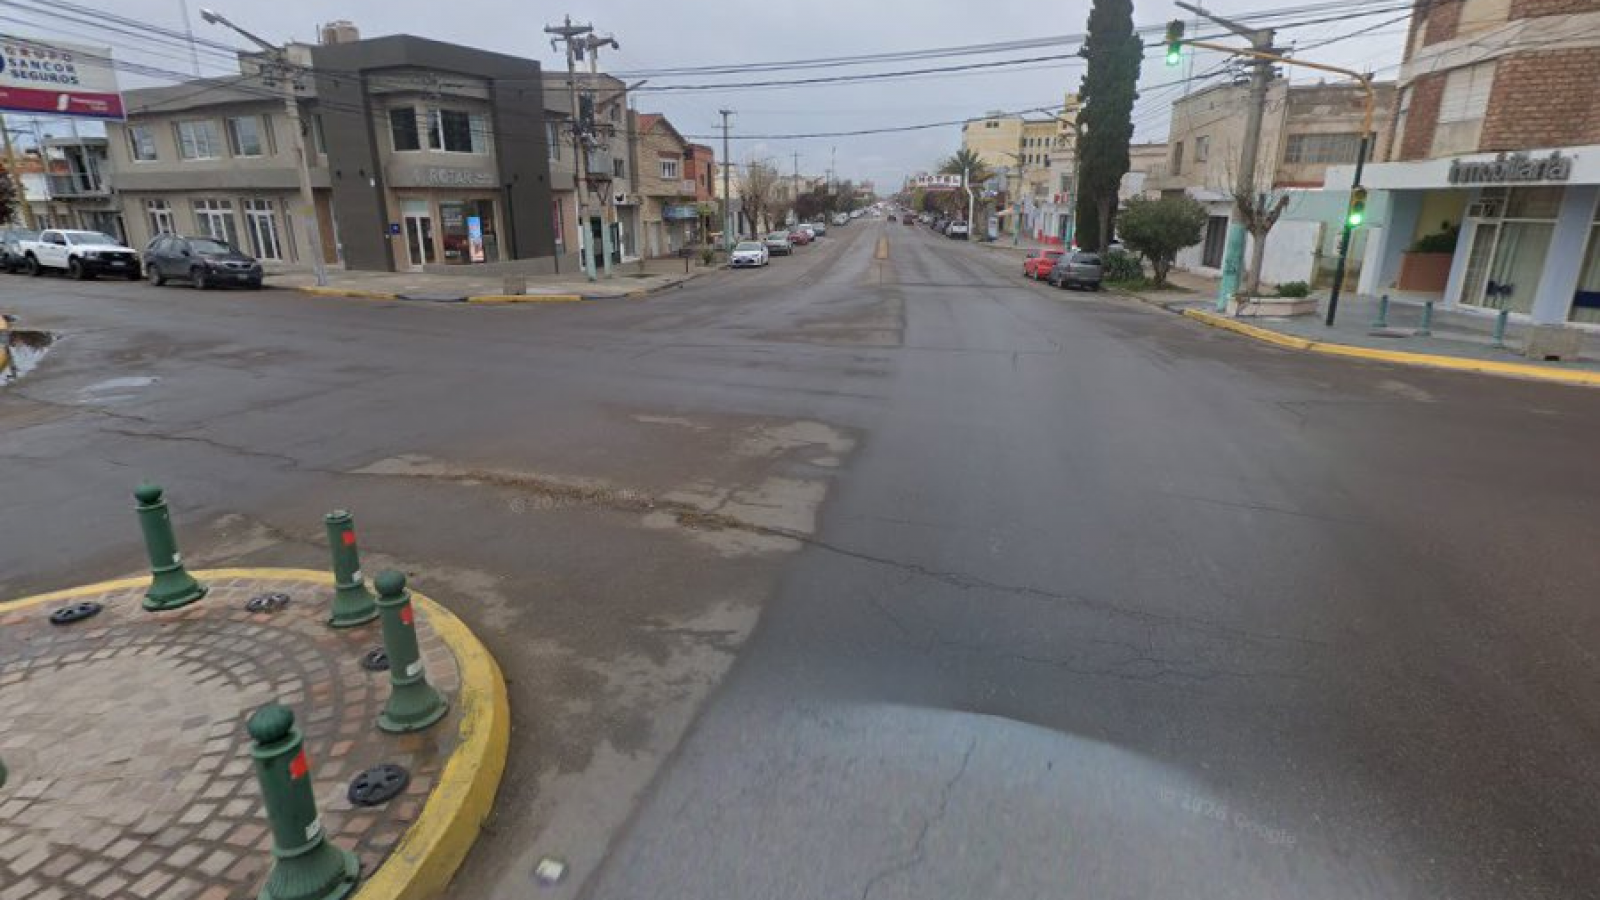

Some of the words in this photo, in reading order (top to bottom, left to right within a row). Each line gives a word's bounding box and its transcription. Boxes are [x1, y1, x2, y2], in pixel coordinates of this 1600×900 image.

[5, 45, 72, 61] GRUPO
[8, 58, 75, 72] SANCOR
[10, 69, 79, 84] SEGUROS
[918, 175, 960, 184] HOTEL
